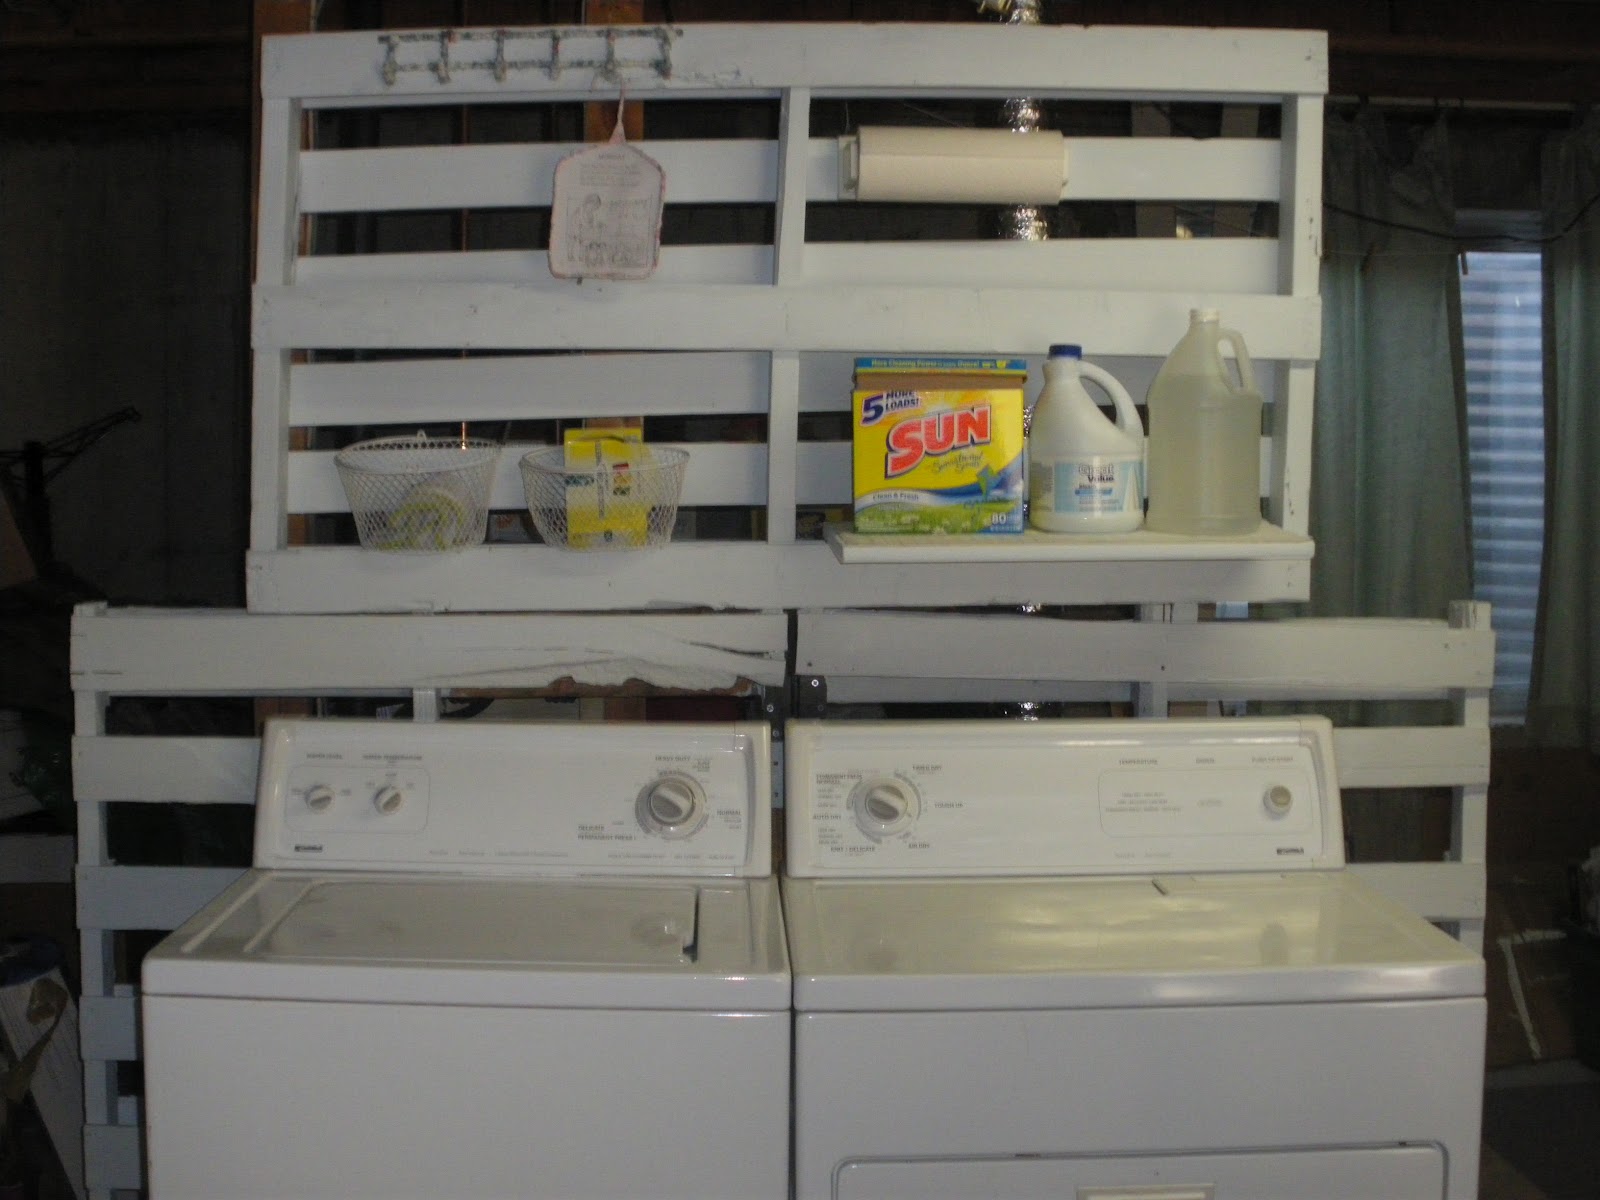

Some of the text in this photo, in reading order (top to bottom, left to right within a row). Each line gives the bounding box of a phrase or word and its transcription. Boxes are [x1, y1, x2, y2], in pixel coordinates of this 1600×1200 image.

[861, 394, 884, 426] 5
[885, 398, 919, 411] LOADS!
[885, 404, 992, 480] SUN
